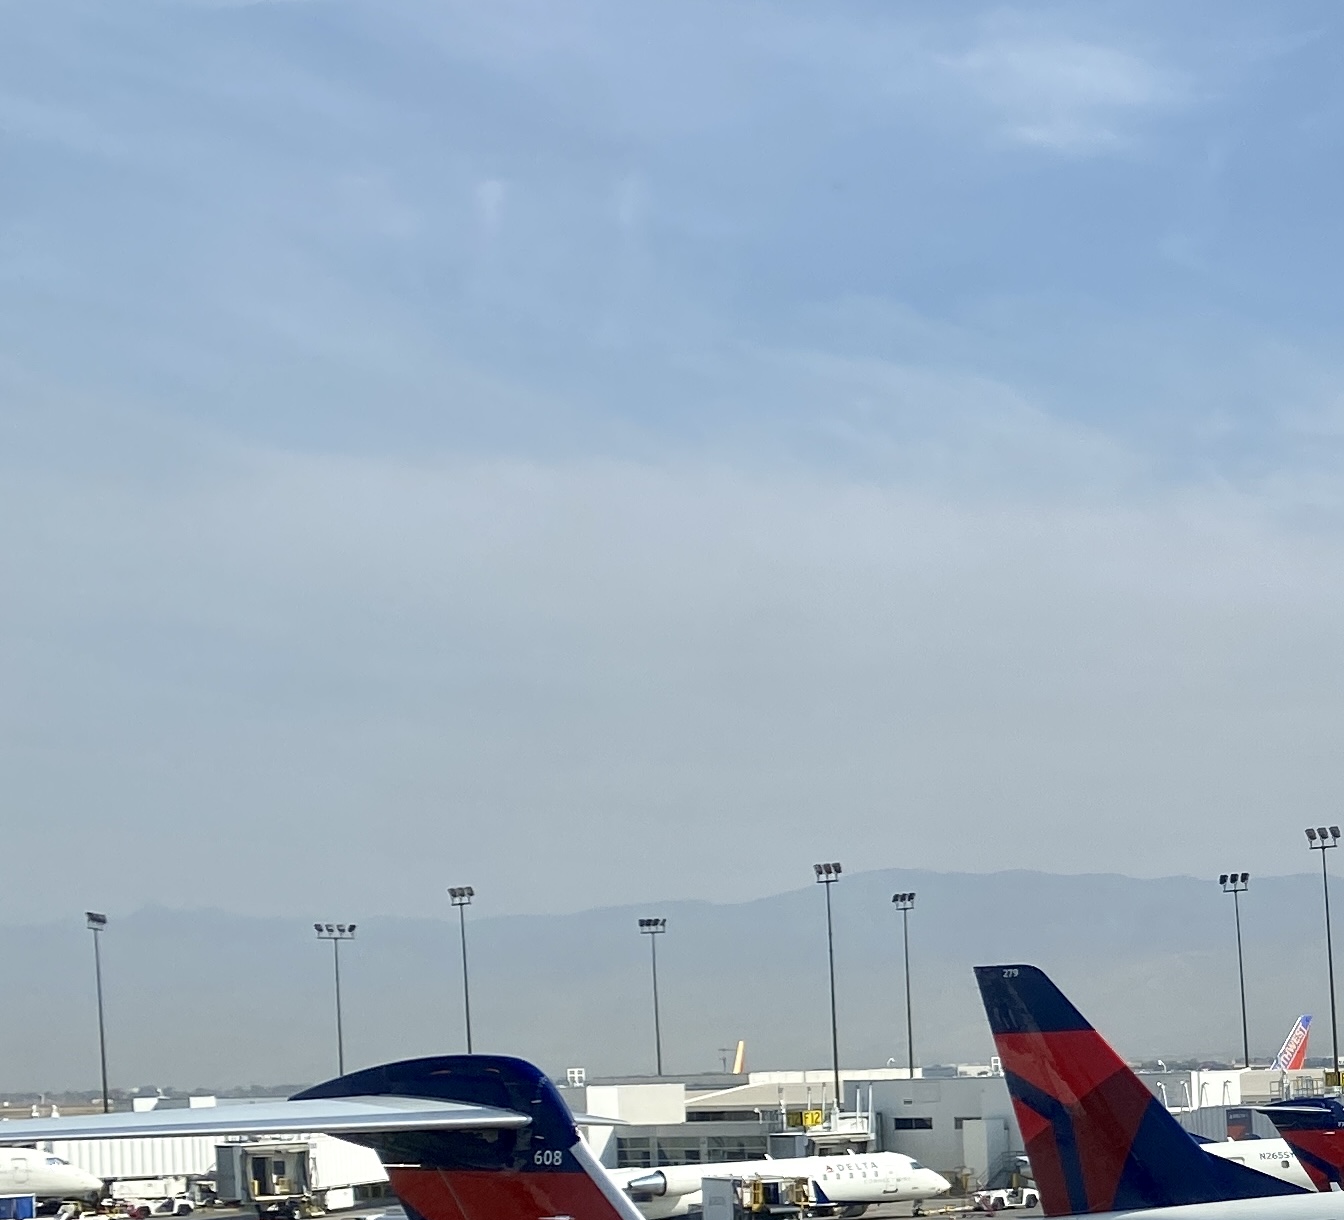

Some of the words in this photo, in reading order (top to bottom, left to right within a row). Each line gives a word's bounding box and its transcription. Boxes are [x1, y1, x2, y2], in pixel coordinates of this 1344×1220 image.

[1003, 969, 1019, 978] 279
[803, 1111, 821, 1124] F12
[534, 1150, 562, 1165] 608
[836, 1161, 878, 1172] DELTA
